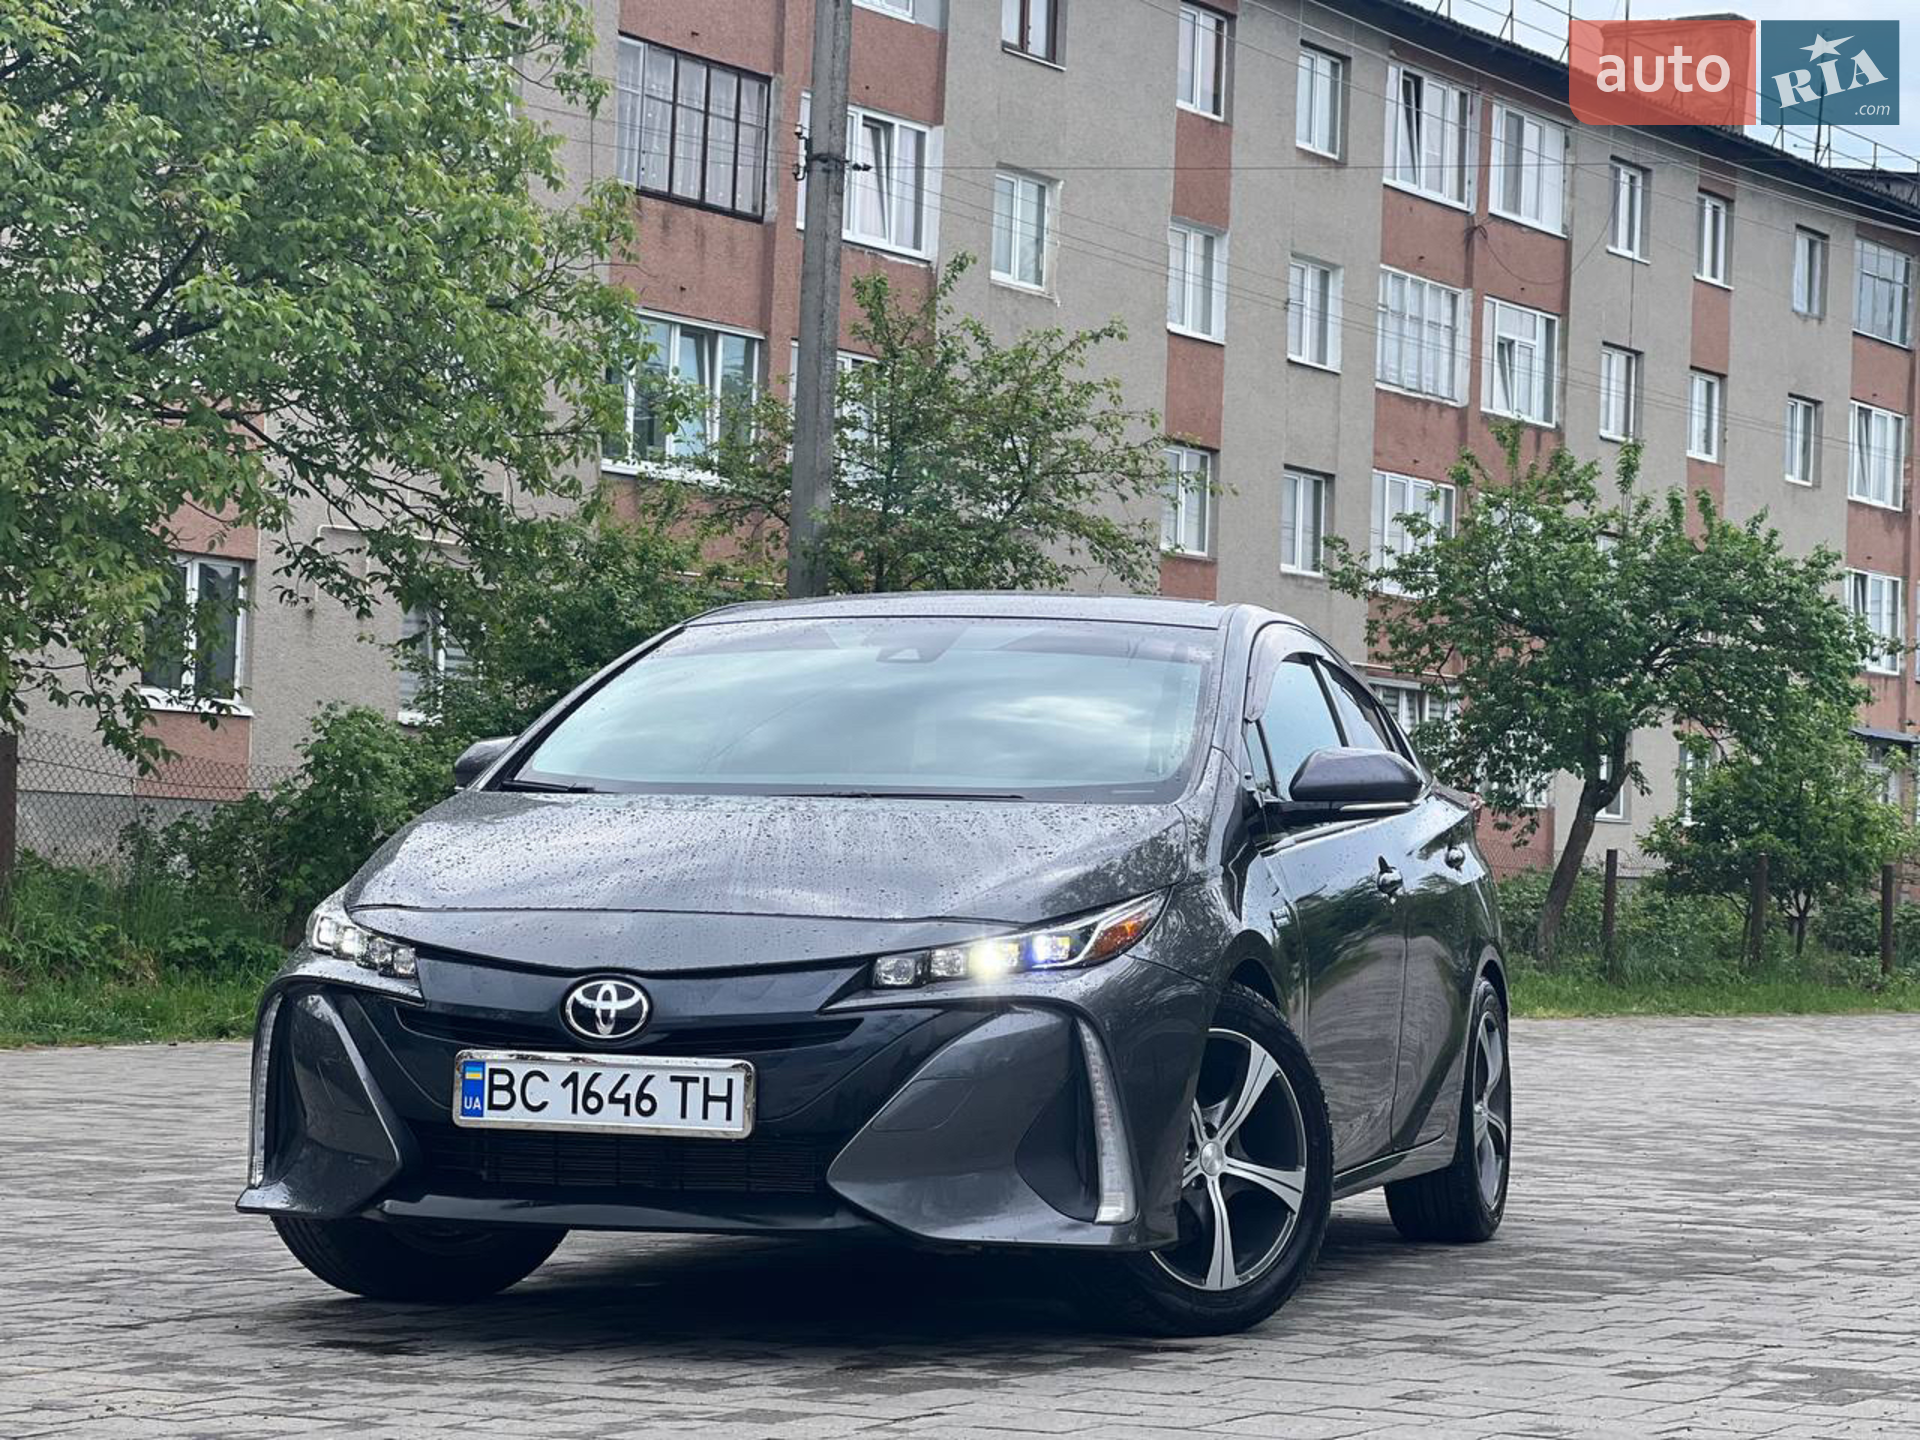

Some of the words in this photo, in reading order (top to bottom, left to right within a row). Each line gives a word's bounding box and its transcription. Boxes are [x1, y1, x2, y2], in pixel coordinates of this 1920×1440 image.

[463, 1096, 482, 1111] UA
[487, 1067, 550, 1112] BC
[560, 1071, 658, 1117] 1646
[670, 1075, 733, 1121] TH
